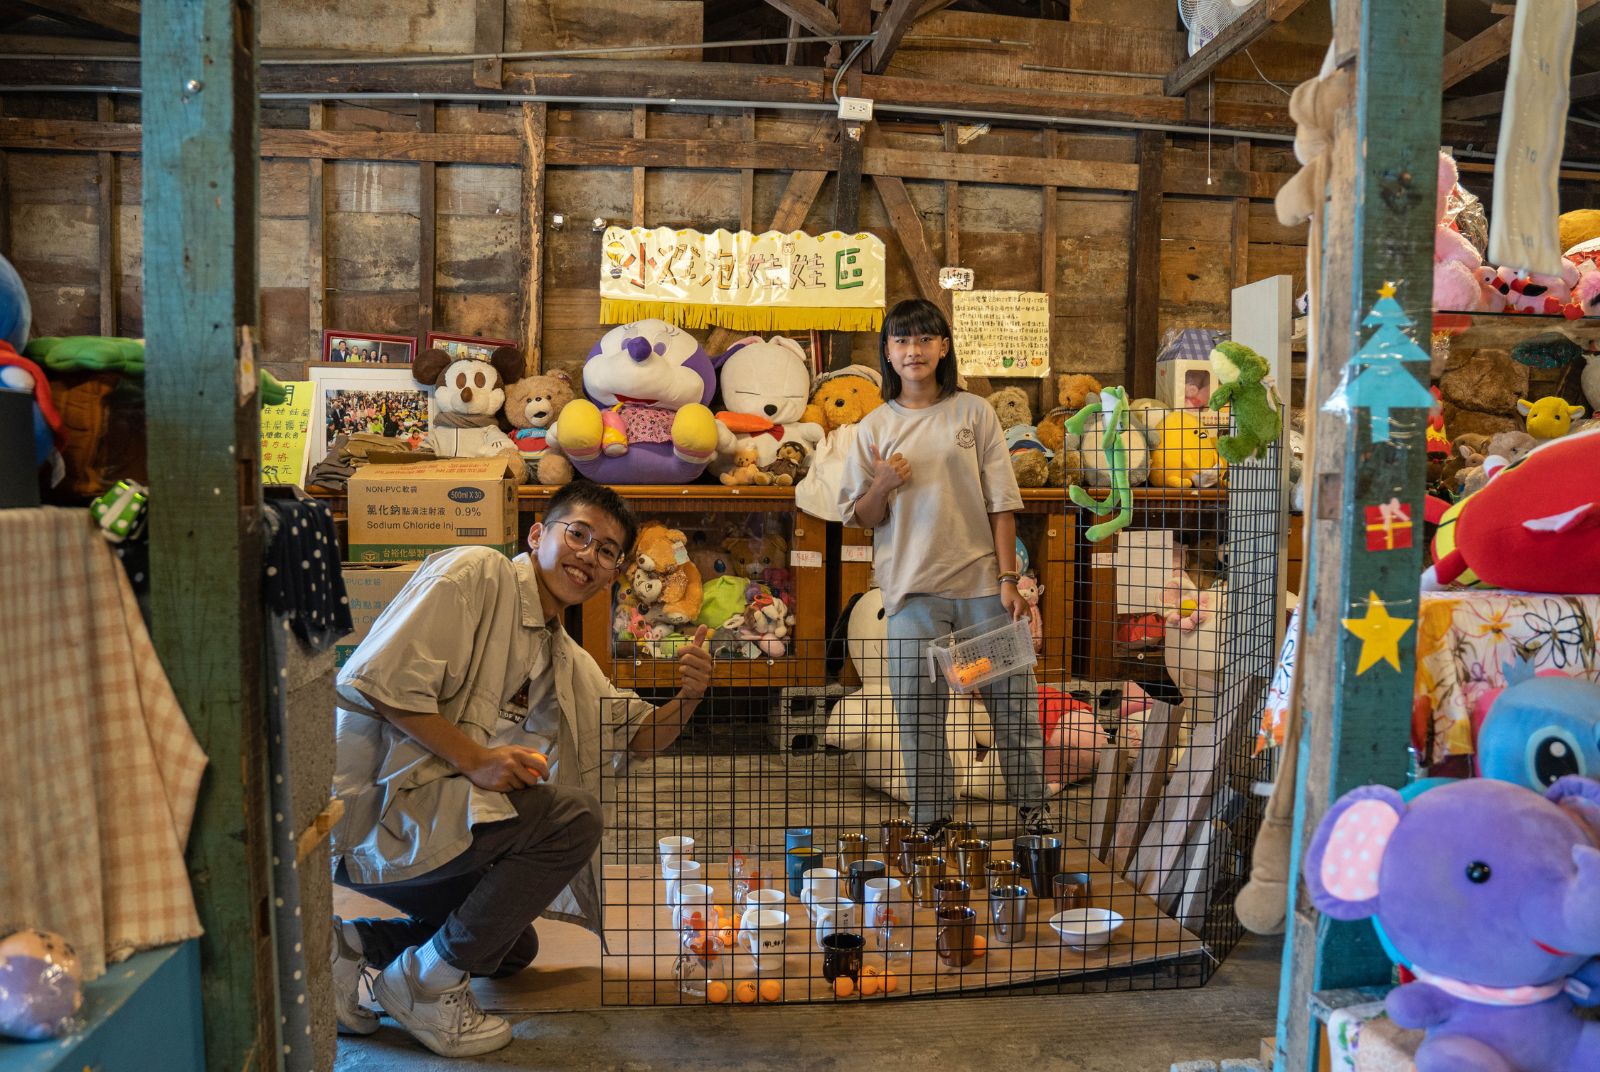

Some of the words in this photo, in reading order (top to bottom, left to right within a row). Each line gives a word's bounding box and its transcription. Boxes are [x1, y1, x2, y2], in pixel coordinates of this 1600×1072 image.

[455, 506, 482, 517] 0.9%
[366, 520, 401, 530] Sodium
[402, 520, 441, 530] Chloride
[443, 520, 457, 532] Inj.
